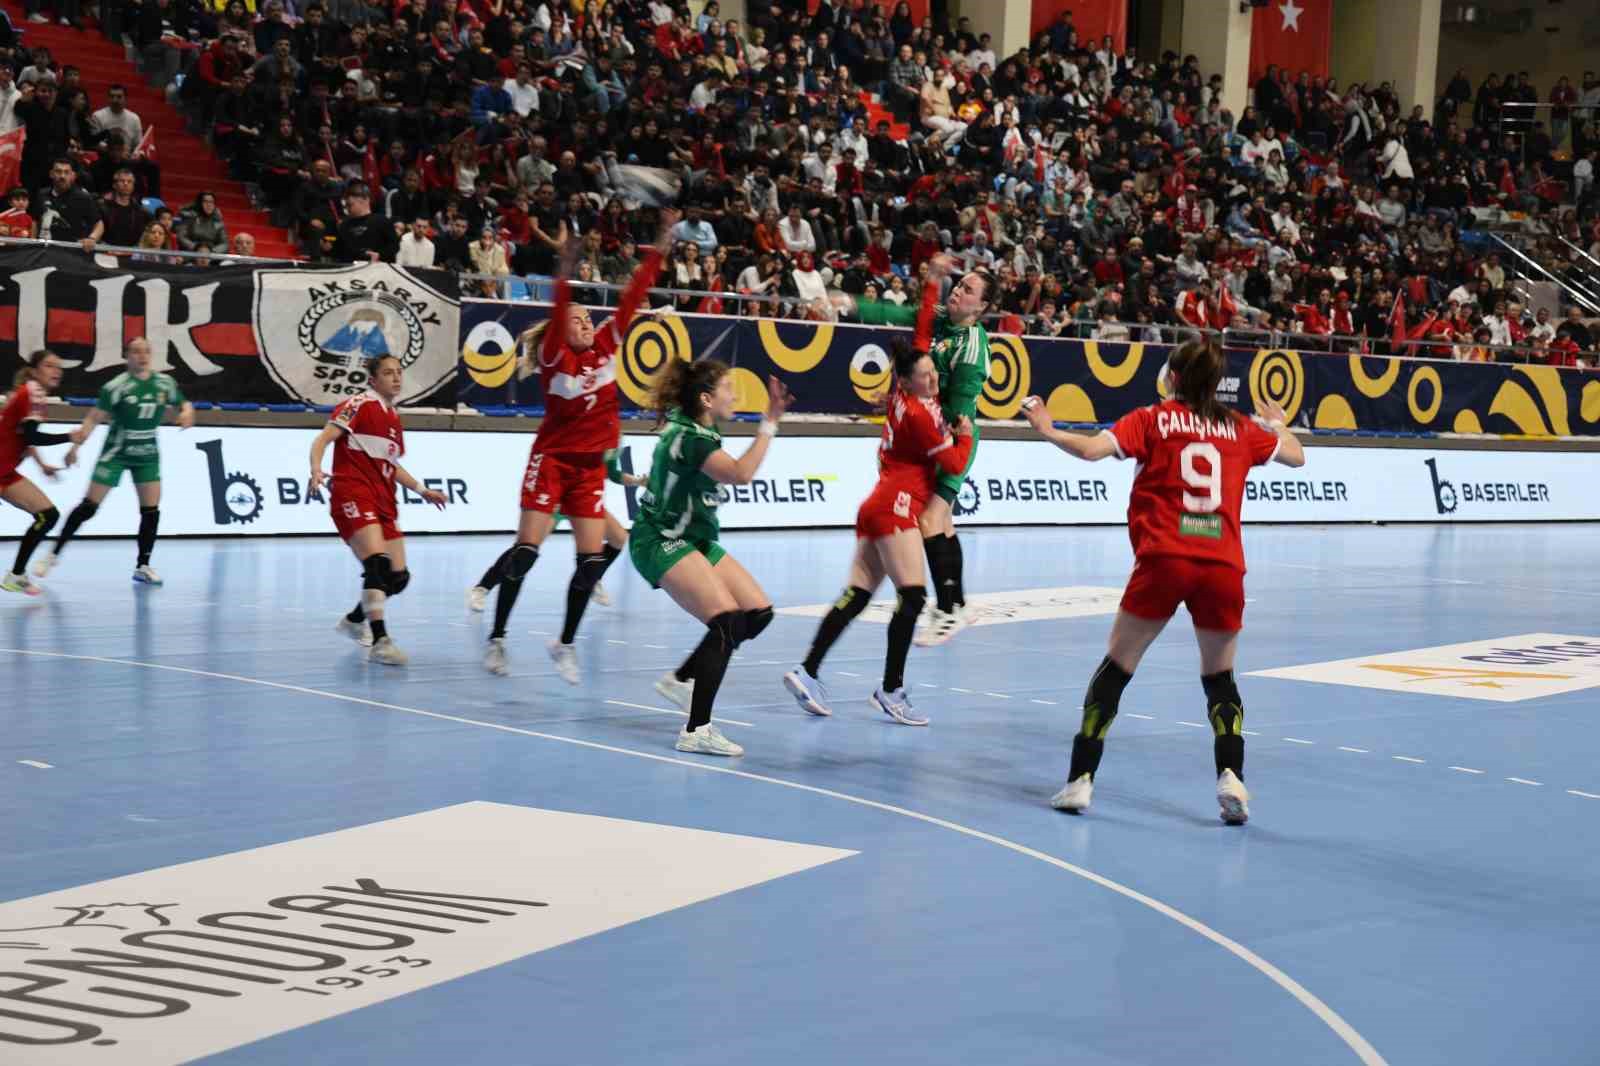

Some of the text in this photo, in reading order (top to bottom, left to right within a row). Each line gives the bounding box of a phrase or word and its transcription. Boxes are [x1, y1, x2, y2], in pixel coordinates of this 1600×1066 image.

[308, 279, 441, 326] AKSARAY
[313, 366, 367, 384] SPO
[584, 393, 598, 410] 7
[1180, 442, 1222, 512] 9
[276, 477, 469, 505] BALER
[724, 479, 826, 503] ERLER
[988, 479, 1109, 501] BASERLER
[1246, 481, 1348, 501] BASERLER
[1462, 483, 1550, 502] BASERLER
[284, 955, 432, 995] 1953
